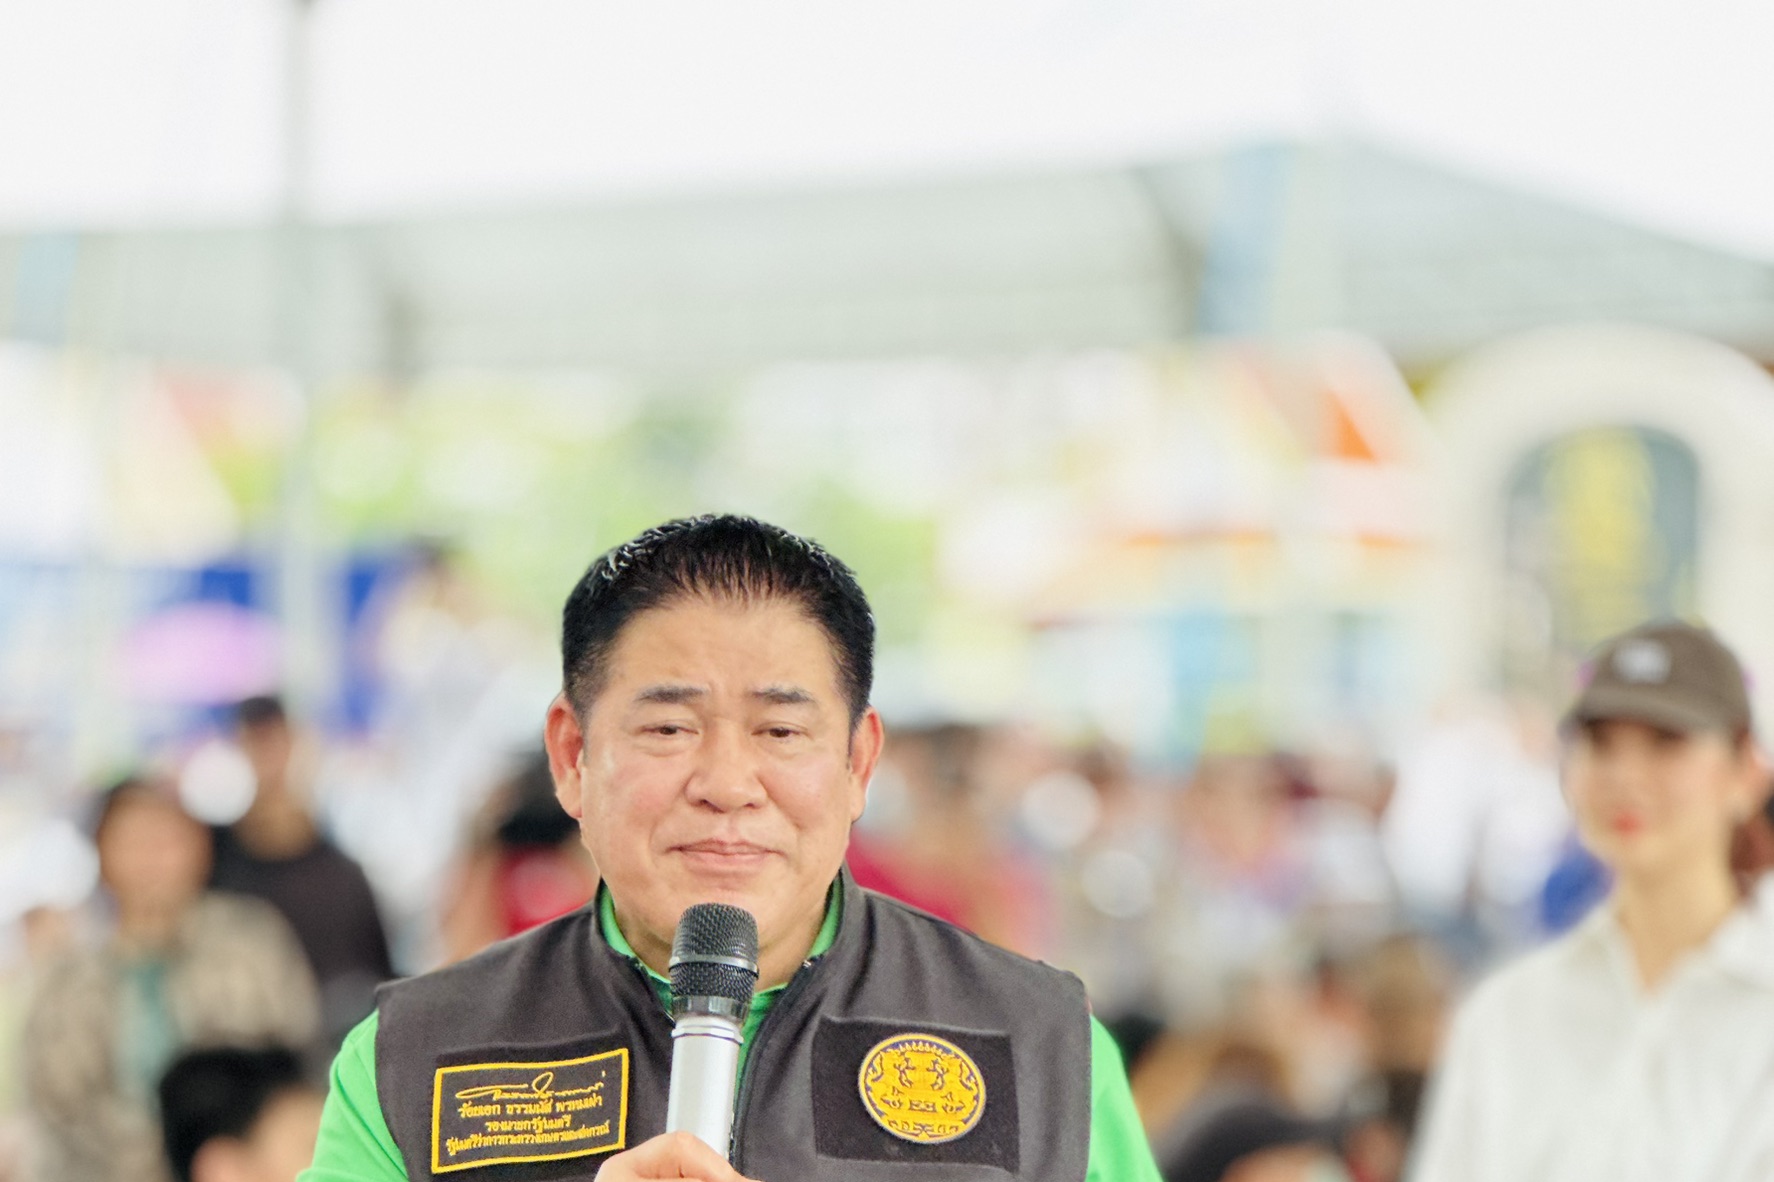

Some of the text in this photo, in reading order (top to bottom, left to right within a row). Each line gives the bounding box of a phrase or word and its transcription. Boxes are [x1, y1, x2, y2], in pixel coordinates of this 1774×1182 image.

[458, 1099, 501, 1118] ร้อยเอก
[506, 1098, 553, 1115] ธรรมนัส
[485, 1114, 572, 1134] รองนายกรัฐมนตรี
